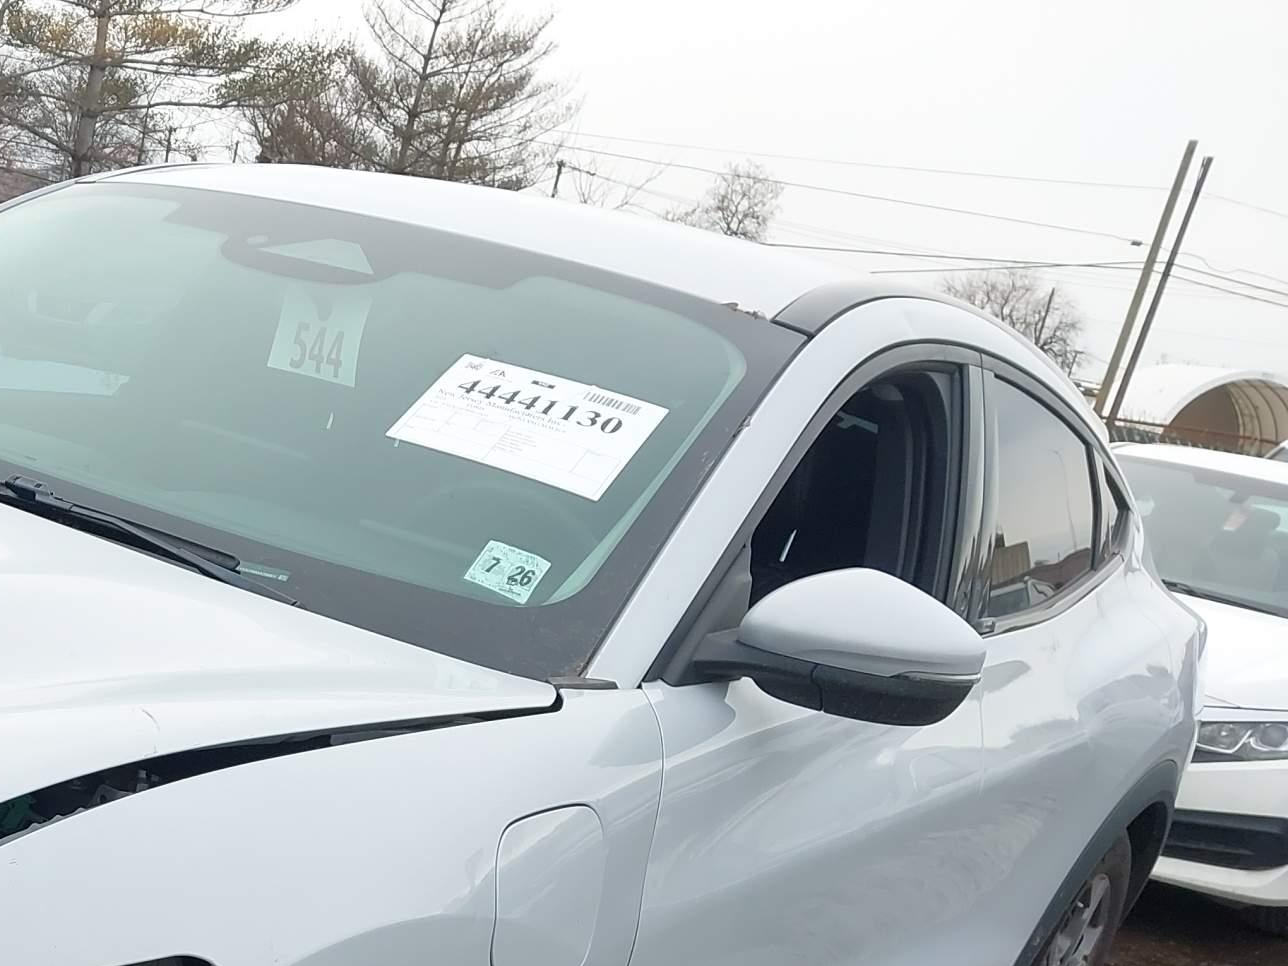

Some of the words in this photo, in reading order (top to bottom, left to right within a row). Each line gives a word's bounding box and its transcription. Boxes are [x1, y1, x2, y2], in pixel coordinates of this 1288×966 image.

[289, 320, 344, 378] 544
[457, 379, 623, 434] 44441130
[485, 556, 502, 573] 7
[506, 566, 536, 587] 26
